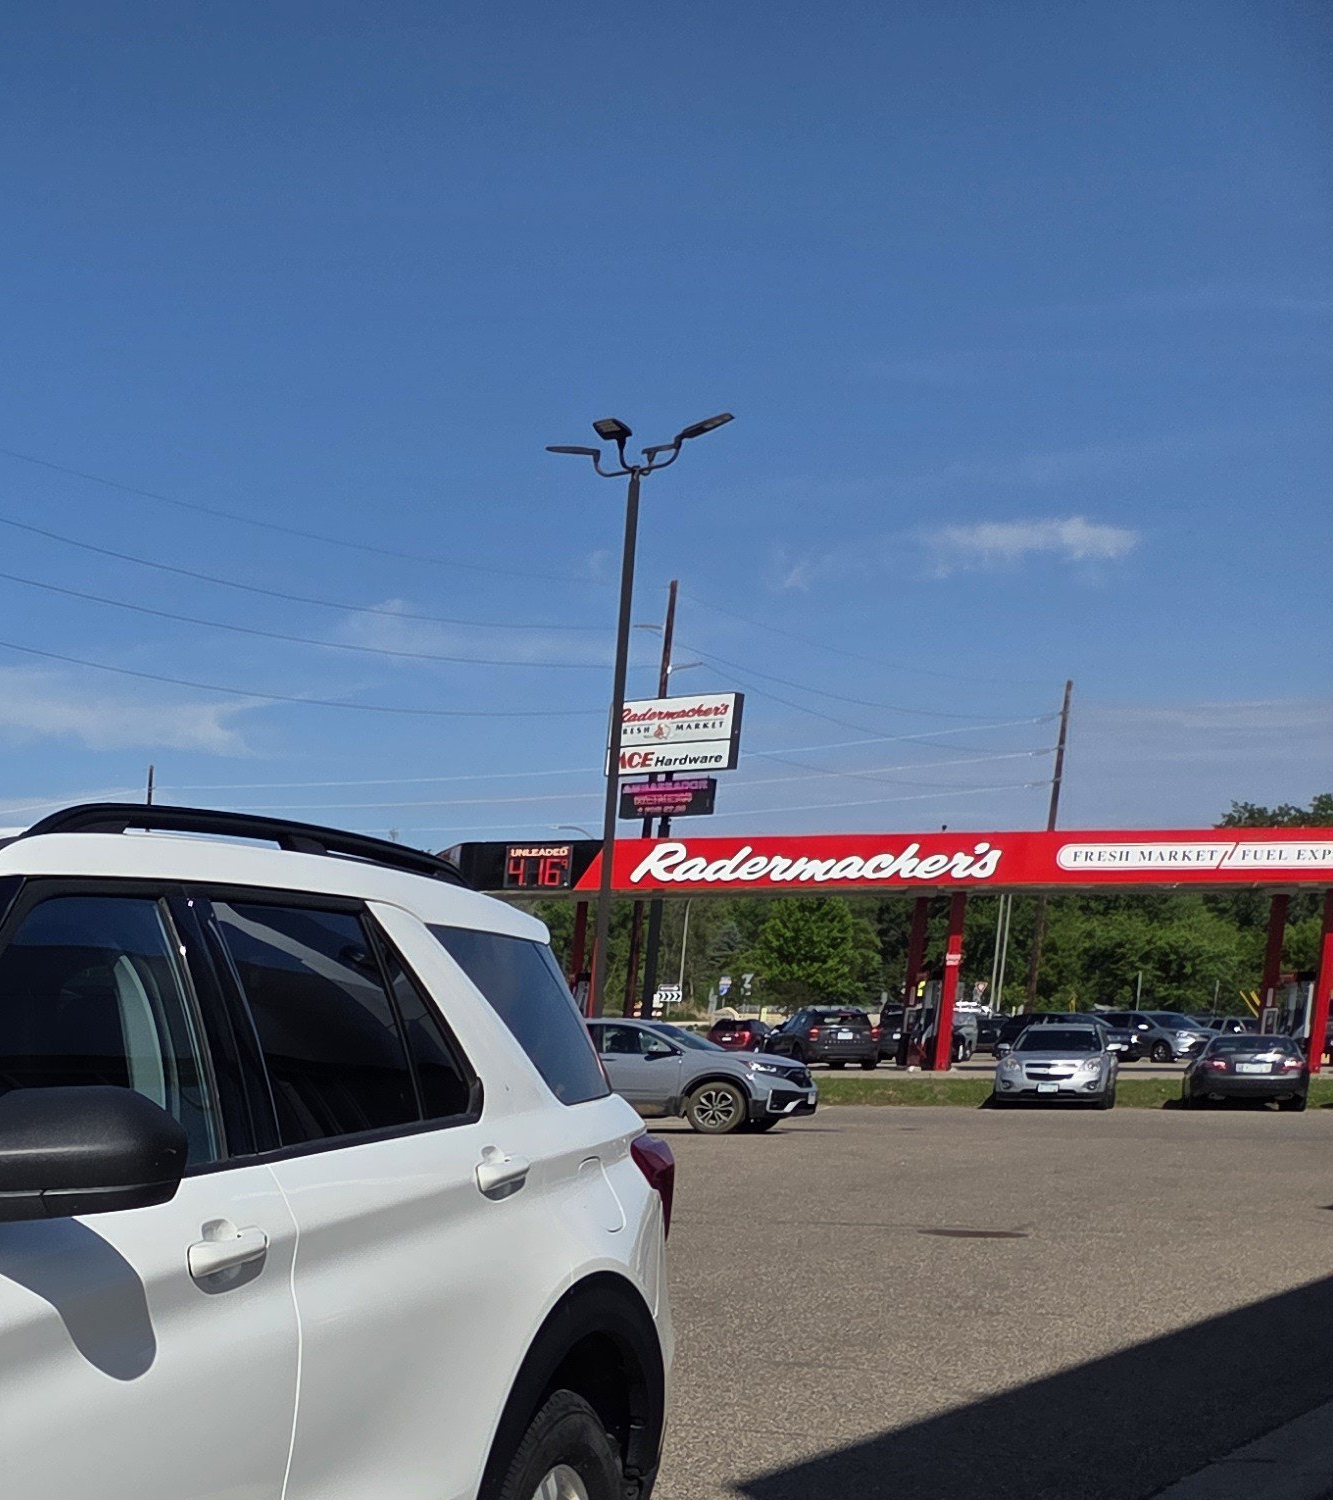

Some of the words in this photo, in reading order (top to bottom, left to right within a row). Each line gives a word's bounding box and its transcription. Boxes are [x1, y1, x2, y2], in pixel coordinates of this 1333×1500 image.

[623, 726, 650, 735] RESH
[675, 721, 724, 731] MARKET
[654, 754, 723, 767] Hardware
[511, 847, 569, 857] UNLEADED
[1073, 850, 1130, 862] FRESH
[1138, 850, 1219, 862] MARKET
[1241, 849, 1288, 861] FUEL
[630, 842, 1002, 883] Radermacher's
